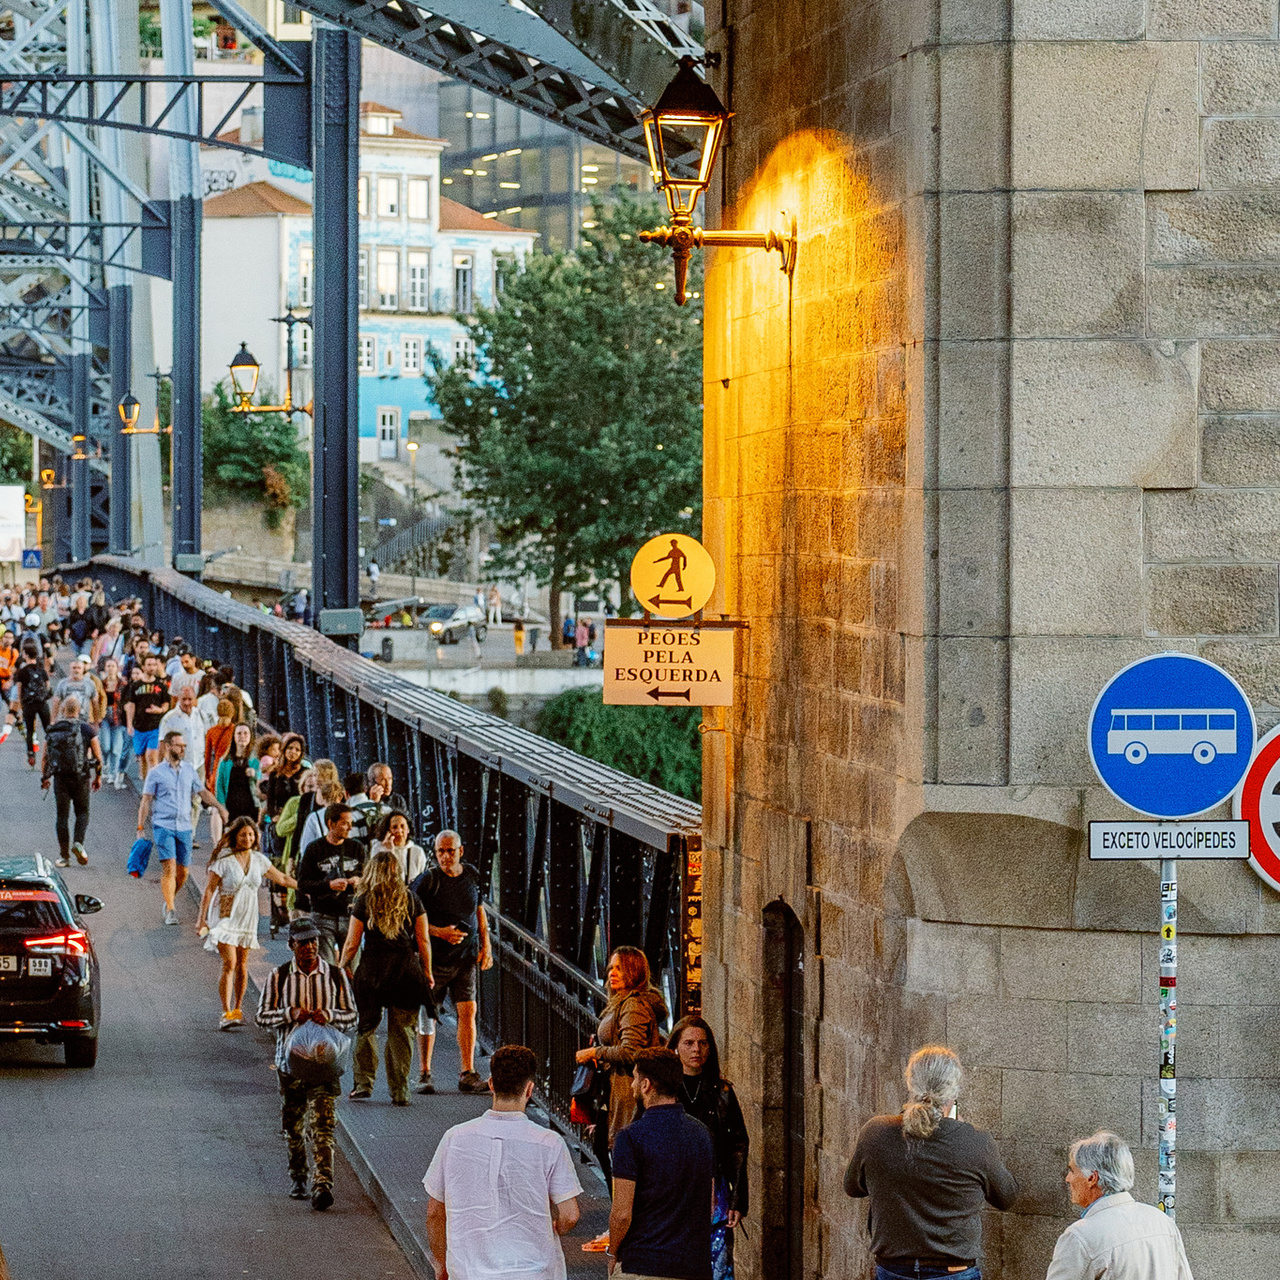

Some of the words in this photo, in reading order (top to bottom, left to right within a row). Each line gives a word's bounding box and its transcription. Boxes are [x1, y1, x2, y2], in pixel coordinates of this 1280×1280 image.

[637, 629, 701, 646] PEÕES
[643, 650, 694, 664] PELA
[614, 668, 722, 684] ESQUERDA
[1102, 832, 1150, 849] EXCETO
[1153, 827, 1236, 849] VELOCÍPEDES
